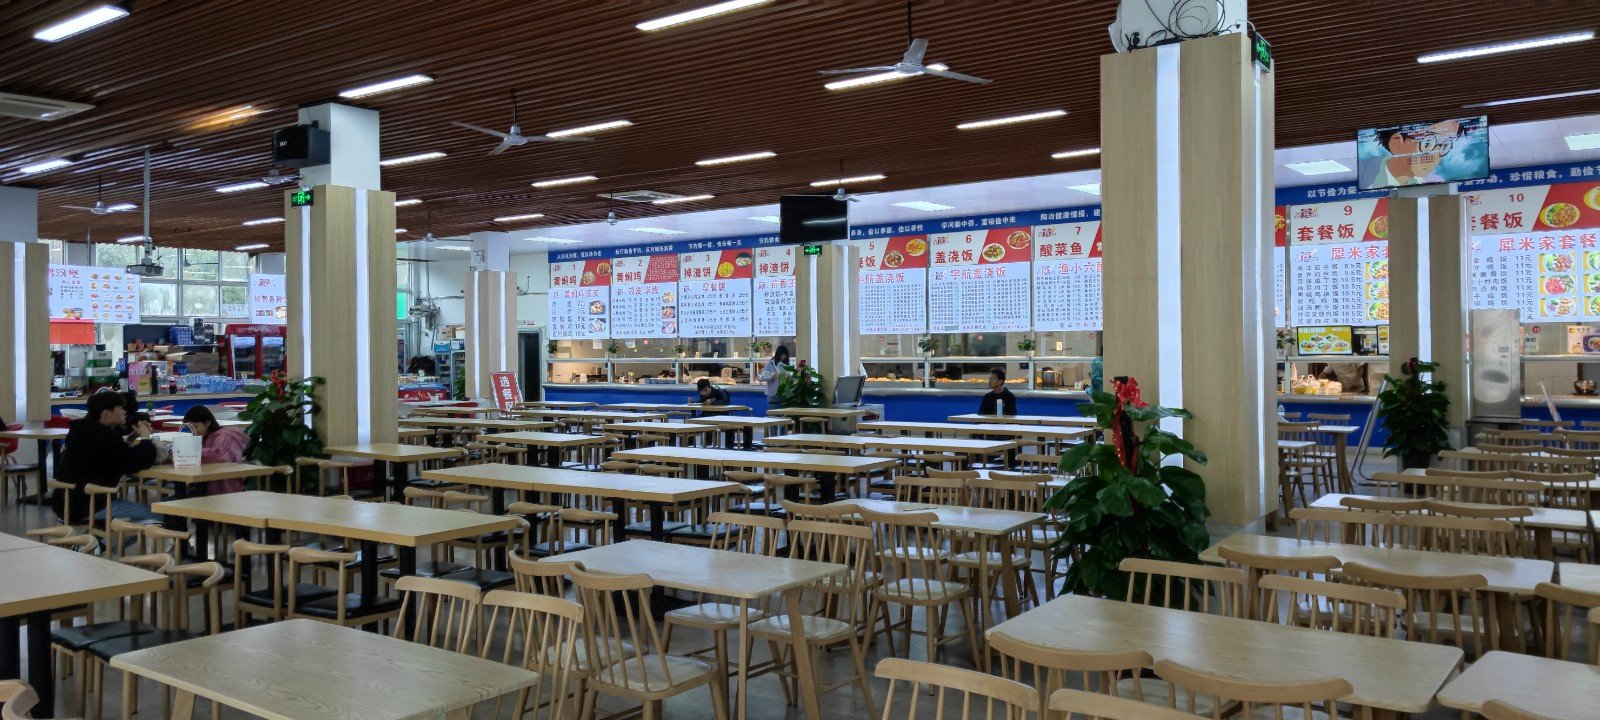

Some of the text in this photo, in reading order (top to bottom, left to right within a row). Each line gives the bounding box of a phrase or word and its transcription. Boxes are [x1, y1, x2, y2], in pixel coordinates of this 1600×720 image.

[1508, 193, 1524, 203] 10
[1344, 205, 1353, 216] 9
[1472, 212, 1524, 231] 餐饭
[1075, 226, 1082, 236] 7
[1297, 223, 1355, 242] 套餐饭
[966, 234, 972, 244] 6
[1498, 233, 1598, 252] 犀米家套餐
[869, 242, 874, 250] 5
[1040, 242, 1083, 258] 酸菜鱼
[935, 250, 974, 264] 盖浇饭
[684, 266, 712, 278] 掉渣饼
[759, 262, 790, 274] 掉渣饼
[554, 276, 577, 286] 黄焖鸡
[616, 272, 642, 282] 黄焖鸡
[499, 376, 514, 412] 选餐区
